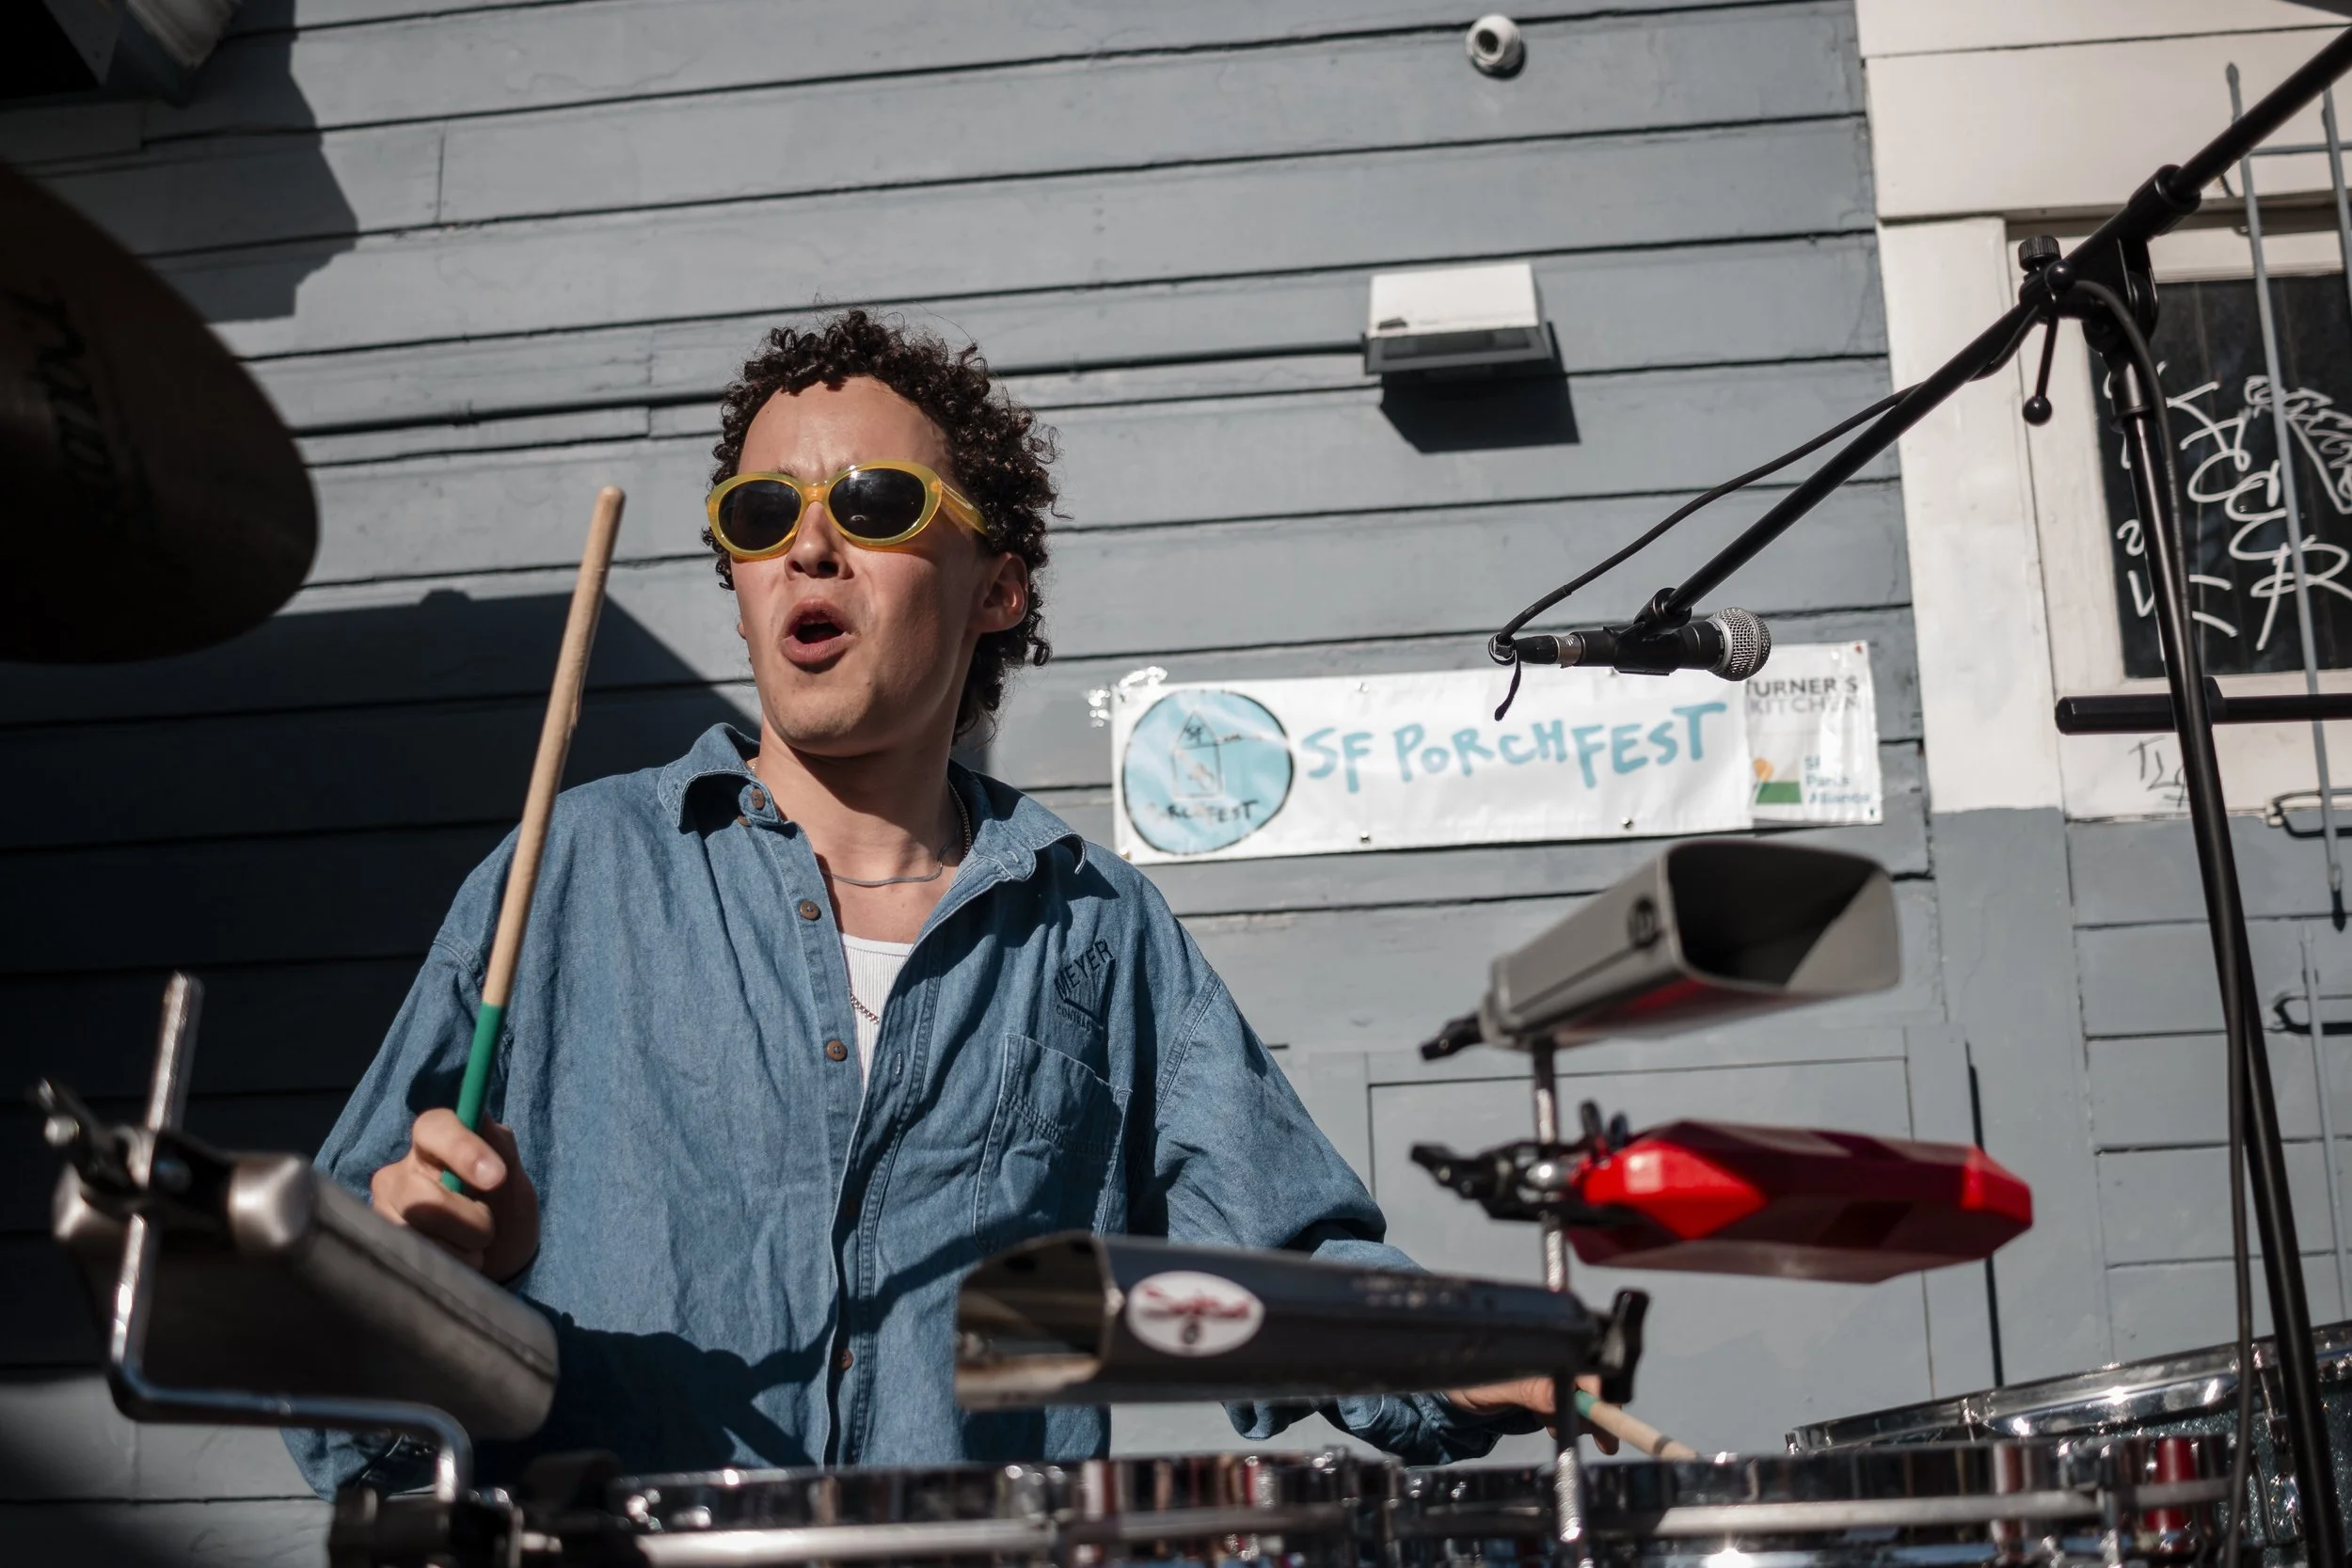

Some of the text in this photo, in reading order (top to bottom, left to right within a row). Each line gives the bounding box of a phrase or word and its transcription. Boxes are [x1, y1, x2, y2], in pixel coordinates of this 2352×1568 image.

[1301, 703, 1727, 793] SF PORCHFEST
[1054, 938, 1114, 1000] MEYER
